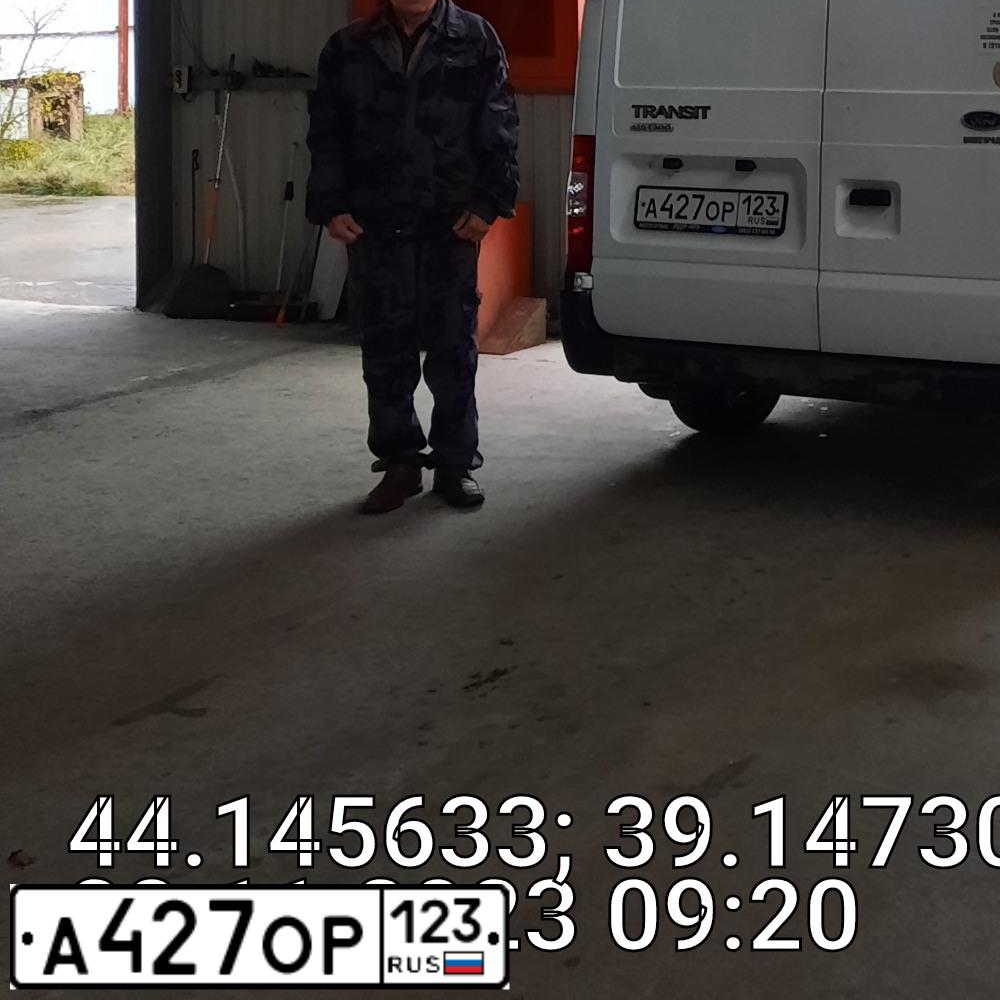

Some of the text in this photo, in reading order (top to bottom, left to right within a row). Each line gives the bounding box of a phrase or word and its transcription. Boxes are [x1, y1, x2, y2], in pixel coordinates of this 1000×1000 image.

[631, 104, 711, 119] TRANSIT
[645, 193, 734, 222] А427ОР
[742, 195, 777, 216] 123
[748, 217, 766, 225] RUS
